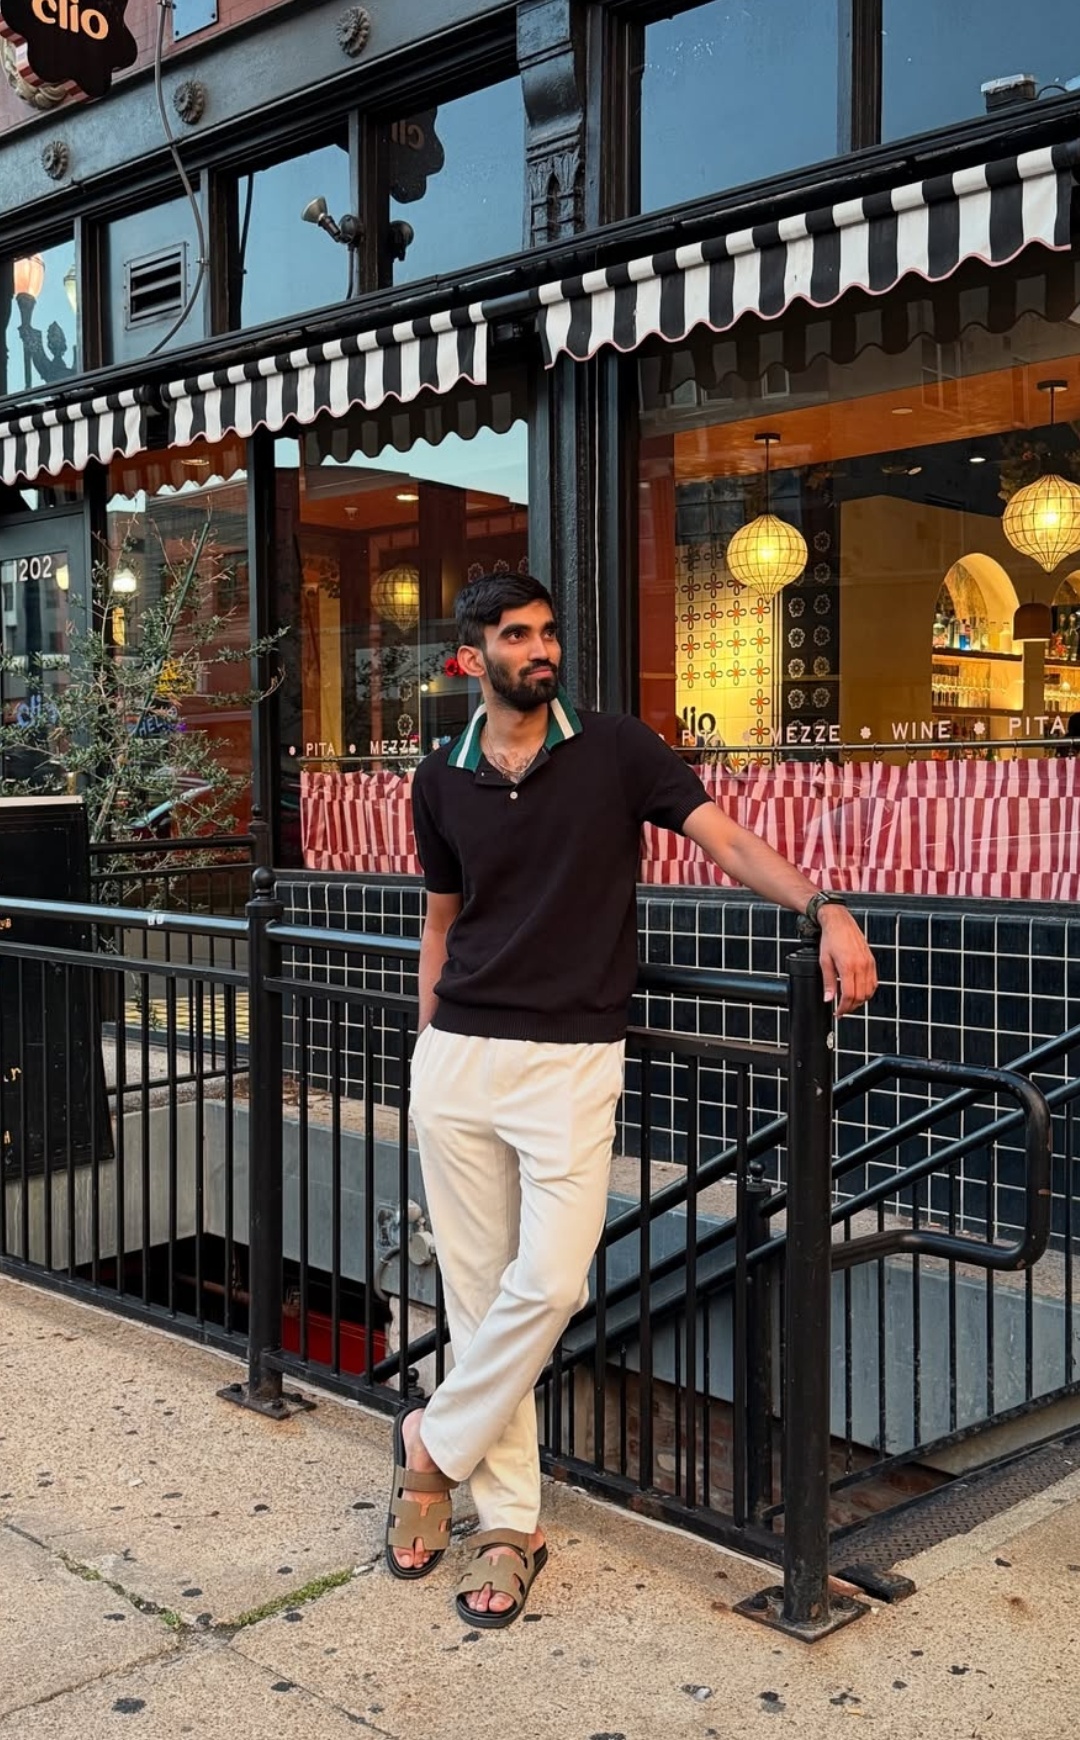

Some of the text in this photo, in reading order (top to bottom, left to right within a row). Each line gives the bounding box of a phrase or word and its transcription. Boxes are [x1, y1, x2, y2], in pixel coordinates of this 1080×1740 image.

[31, 0, 109, 40] clio
[19, 555, 52, 582] 202
[682, 706, 716, 738] lio
[769, 724, 841, 746] MEZZE
[891, 720, 952, 741] WINE
[1008, 715, 1067, 737] PITA
[305, 739, 420, 757] PITA MEZZE
